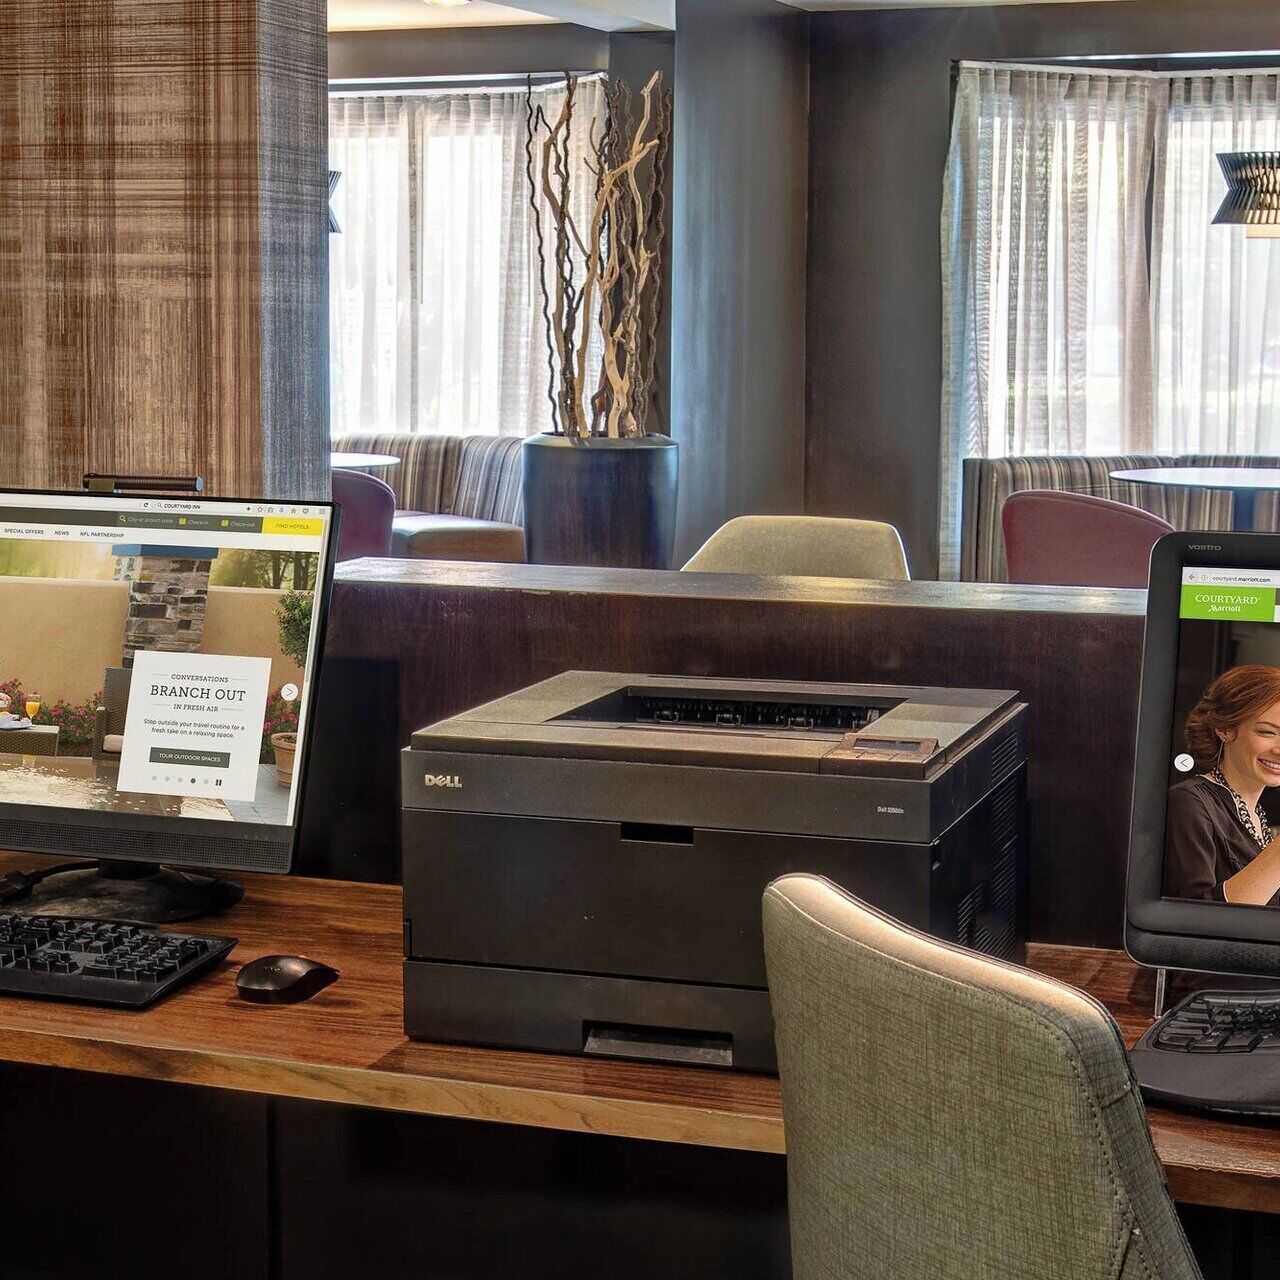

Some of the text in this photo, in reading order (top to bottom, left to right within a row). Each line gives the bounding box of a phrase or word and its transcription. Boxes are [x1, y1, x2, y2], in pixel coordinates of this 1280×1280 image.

[1195, 594, 1258, 605] COURTYARD
[1208, 604, 1241, 613] Marriott
[171, 673, 229, 683] CONVERSATIONS
[150, 685, 246, 701] BRANCH OUT
[183, 704, 205, 712] FRESH
[143, 718, 157, 726] Step
[193, 730, 216, 738] relaxing
[425, 774, 463, 788] DELL
